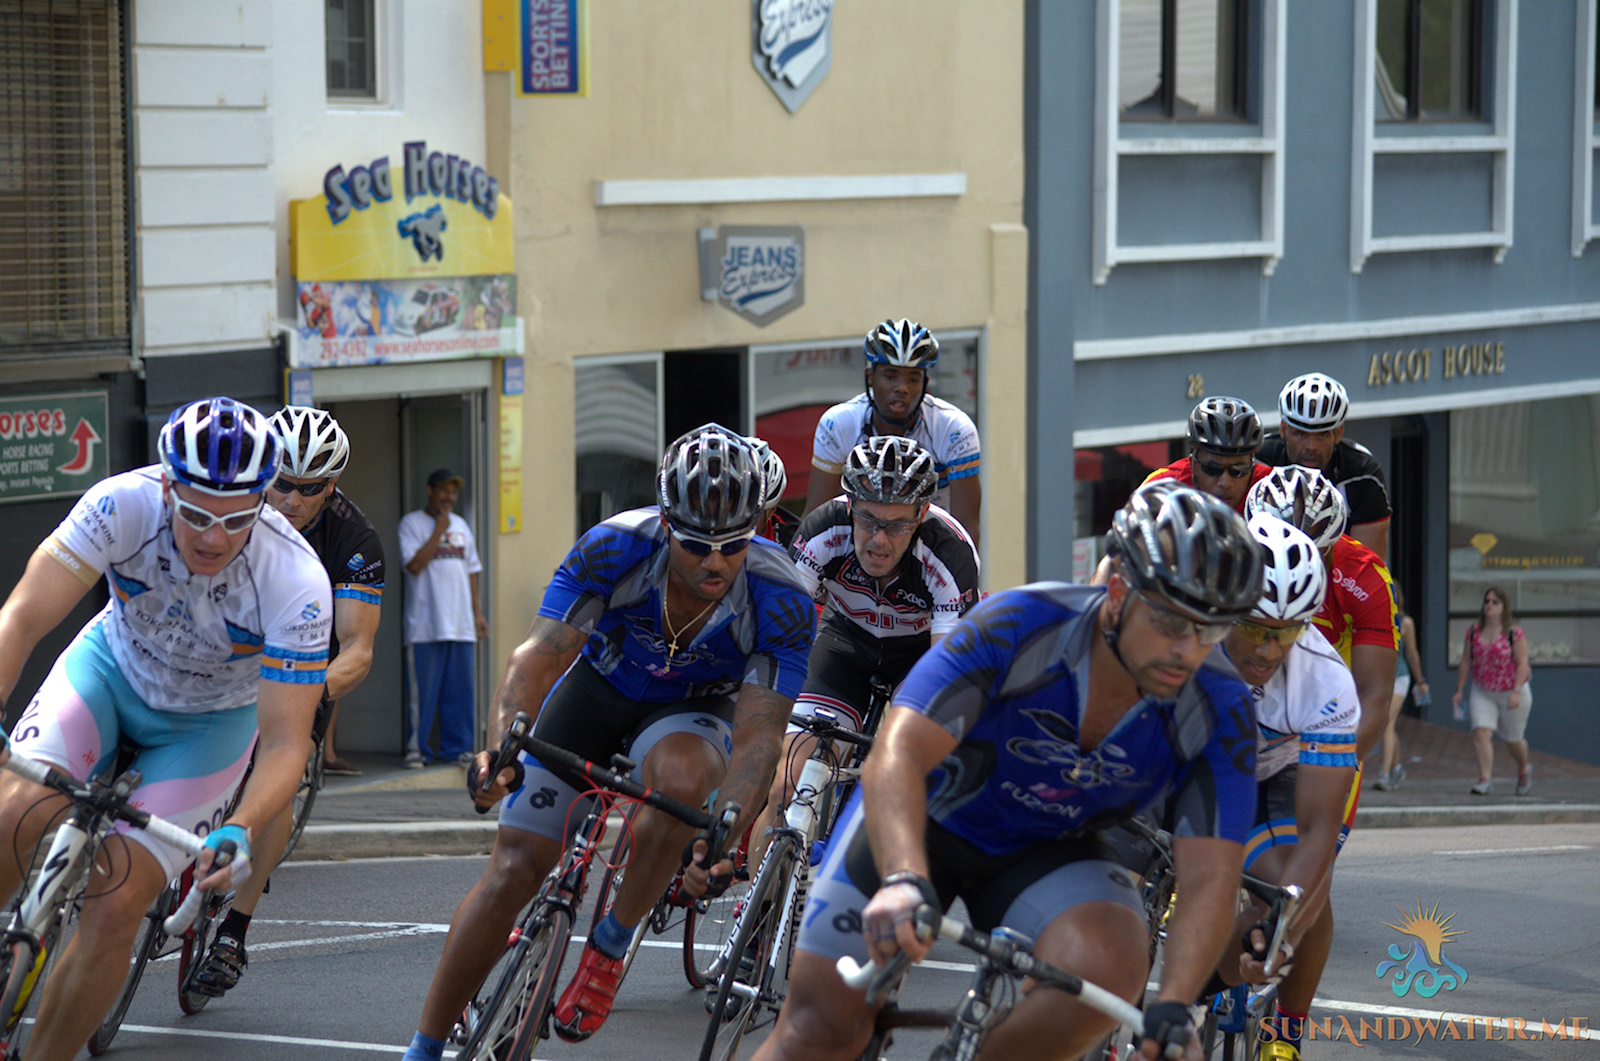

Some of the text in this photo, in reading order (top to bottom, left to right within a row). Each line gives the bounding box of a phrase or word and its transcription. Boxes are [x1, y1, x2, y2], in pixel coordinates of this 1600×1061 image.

[531, 0, 550, 90] SPORTS
[550, 0, 570, 89] BETTIN
[324, 140, 499, 226] Sea Horses
[724, 245, 797, 269] JEANS
[1367, 350, 1433, 387] ASCOT
[1443, 342, 1507, 380] HOUSE
[933, 602, 967, 615] CYCLES
